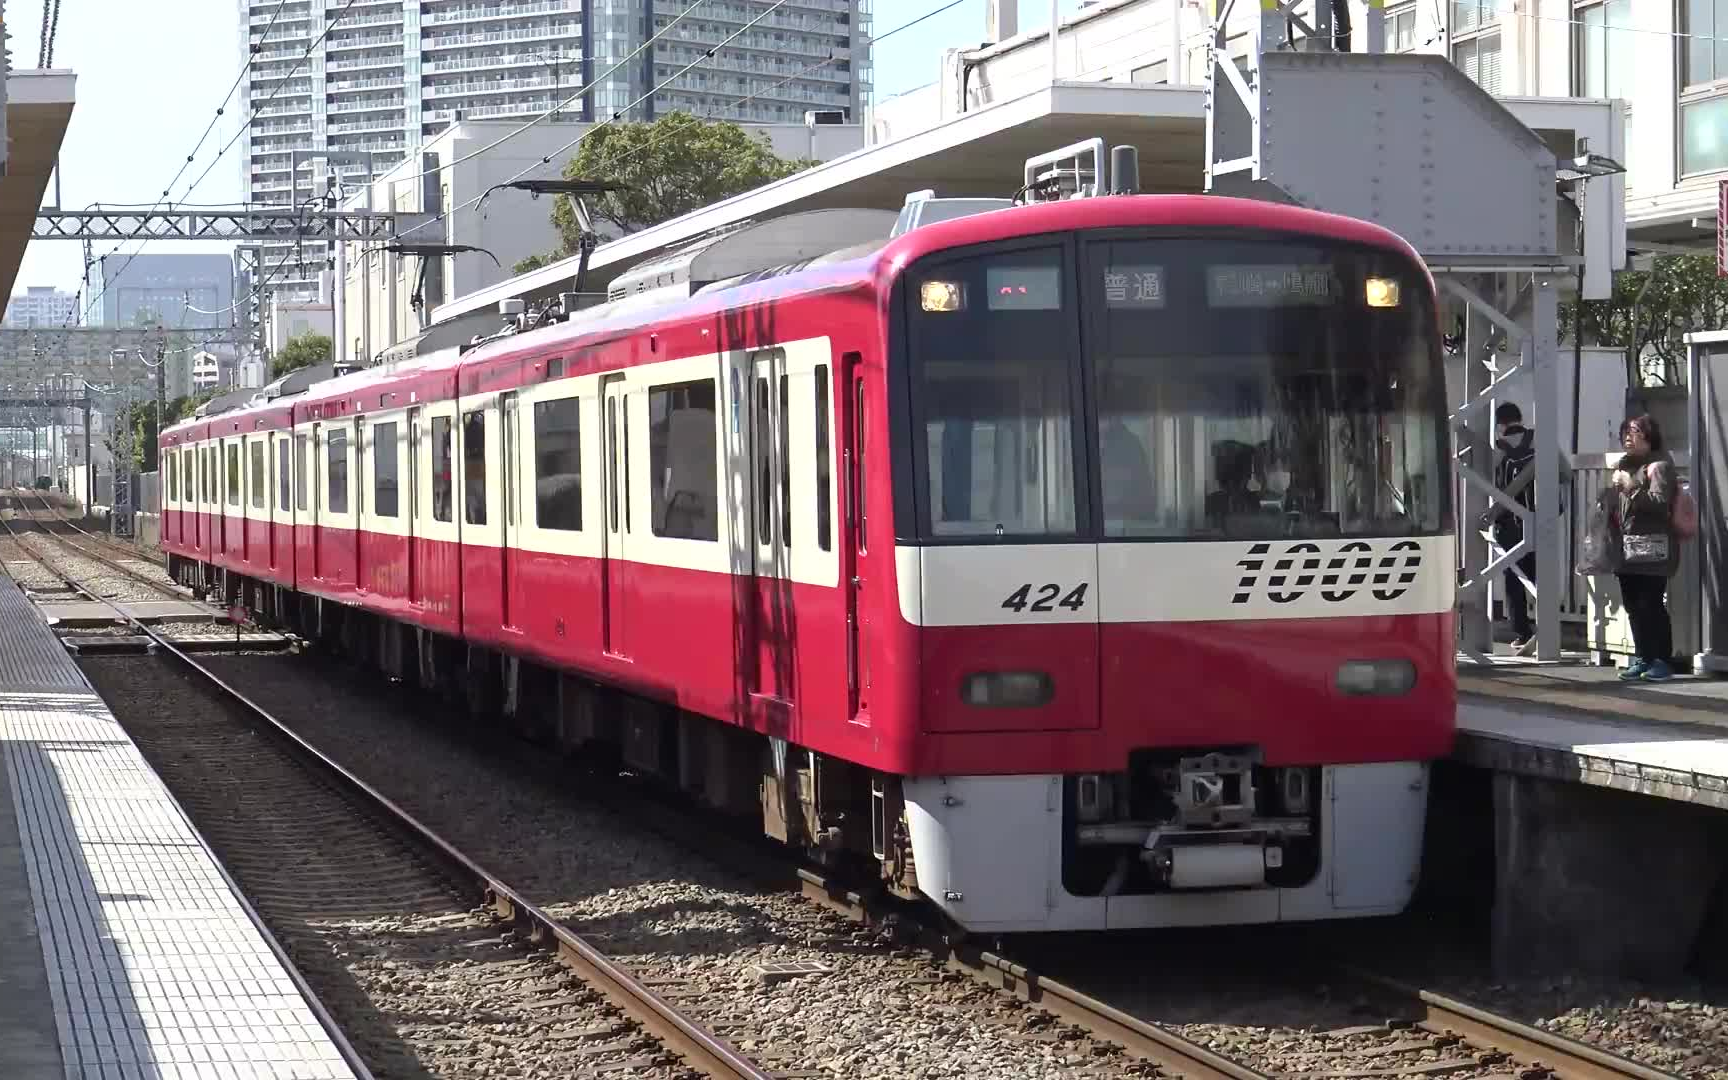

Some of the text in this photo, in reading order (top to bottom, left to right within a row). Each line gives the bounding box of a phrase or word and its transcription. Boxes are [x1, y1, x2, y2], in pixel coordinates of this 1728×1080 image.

[1105, 273, 1161, 301] 普通
[1231, 540, 1422, 604] 1000
[1001, 583, 1089, 612] 424
